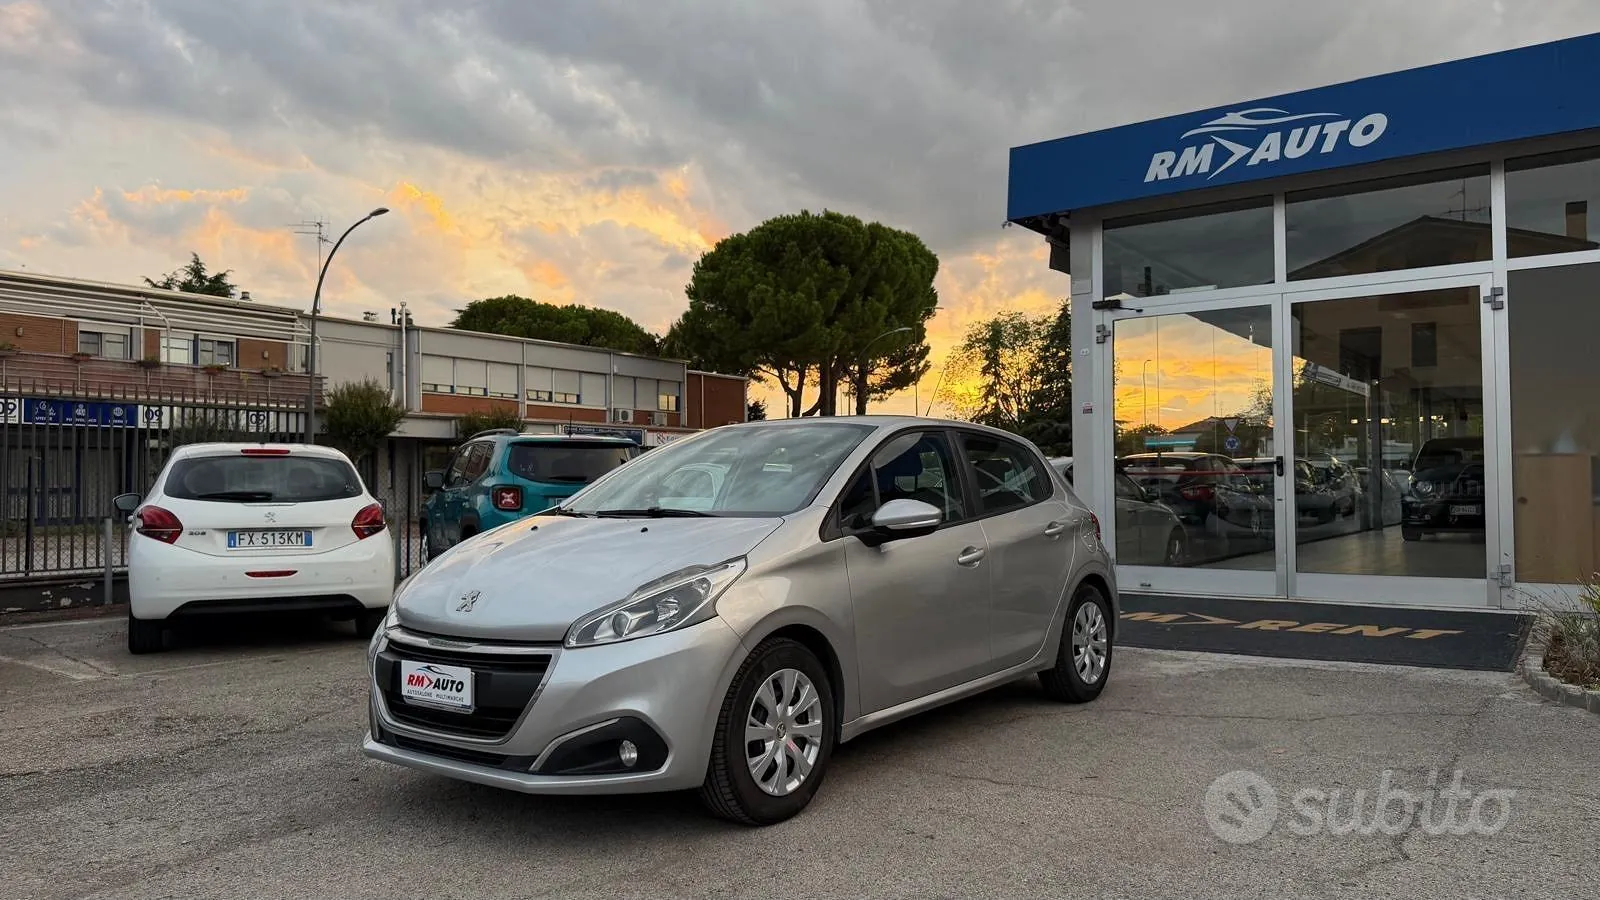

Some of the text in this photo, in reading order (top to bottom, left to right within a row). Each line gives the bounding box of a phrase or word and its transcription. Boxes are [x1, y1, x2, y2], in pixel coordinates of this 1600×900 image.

[1144, 113, 1388, 182] RM AUTO
[1120, 609, 1464, 639] M RENT
[407, 674, 465, 693] RM AUTO
